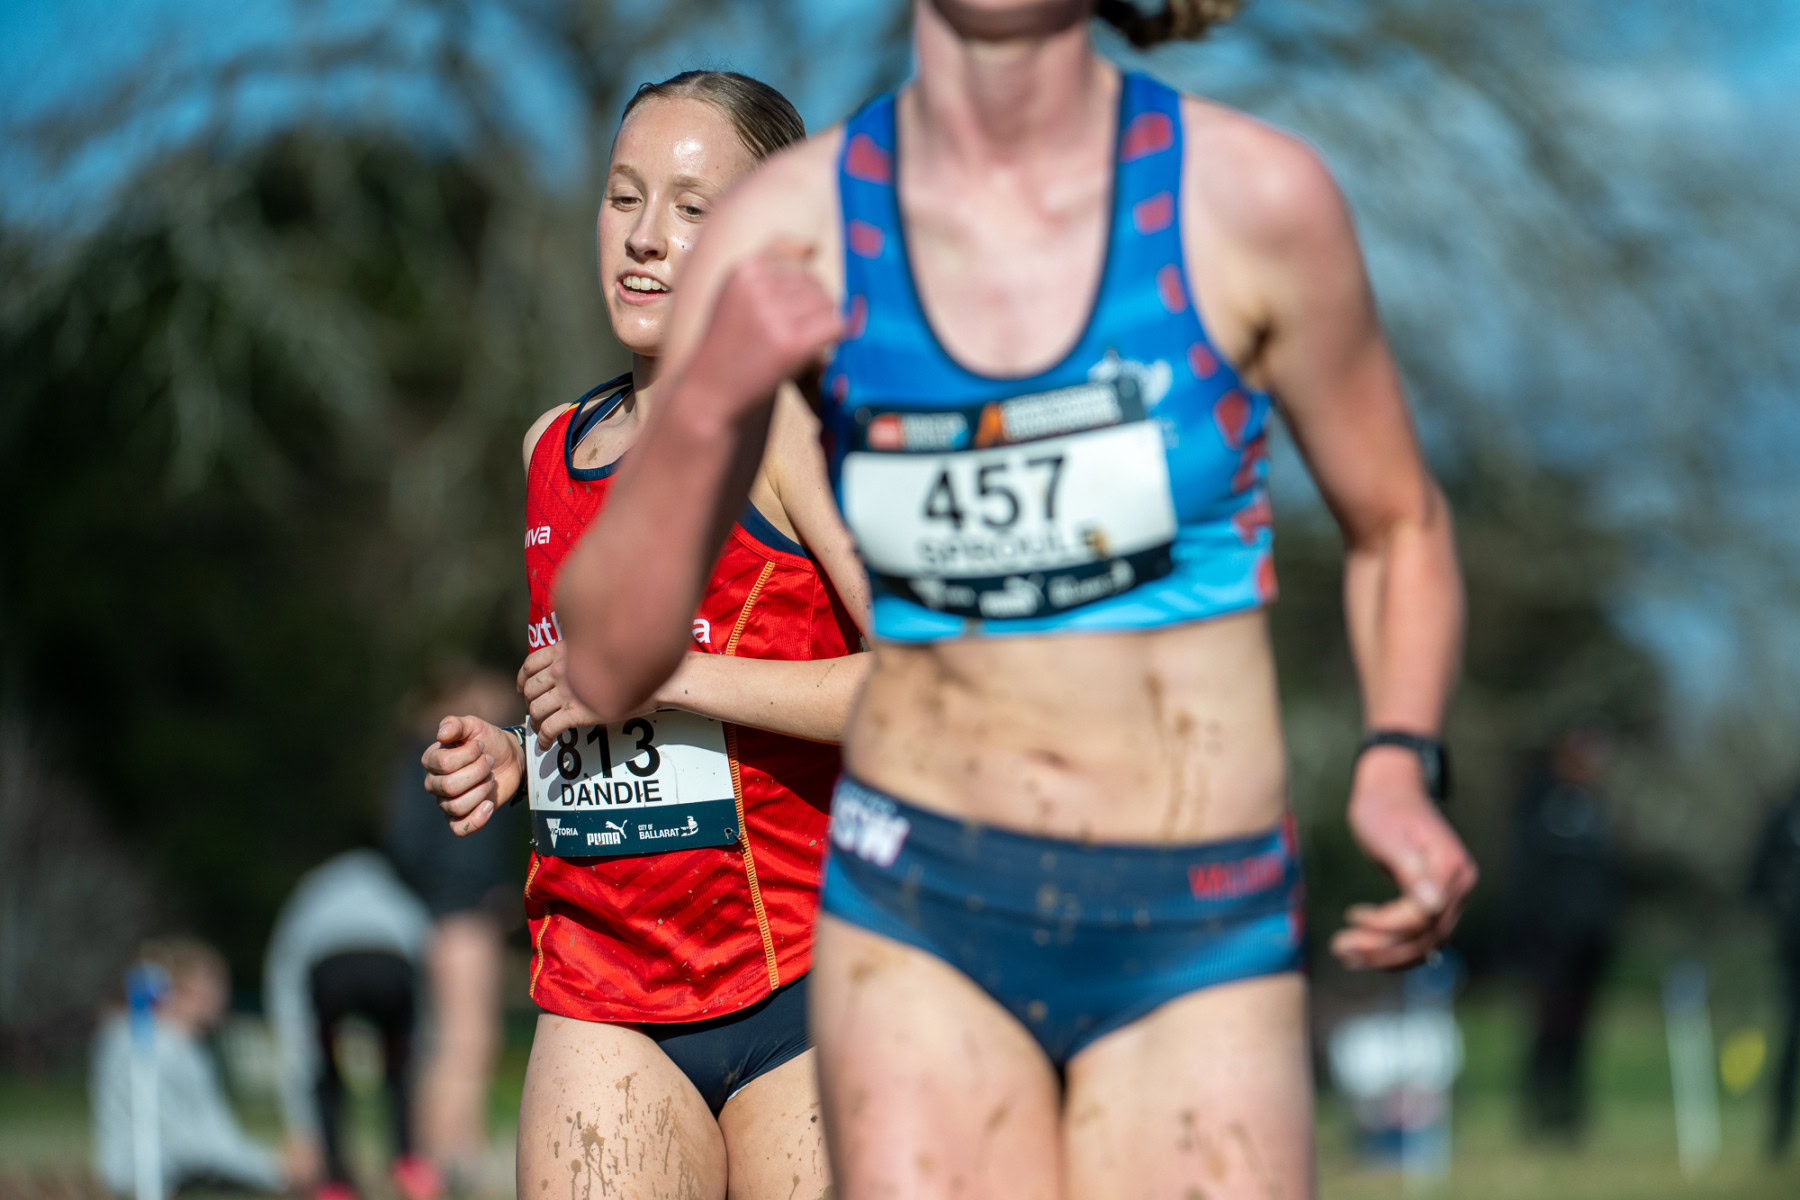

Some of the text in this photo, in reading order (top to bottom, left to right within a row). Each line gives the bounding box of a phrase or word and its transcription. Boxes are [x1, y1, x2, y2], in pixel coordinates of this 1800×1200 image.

[922, 455, 1068, 530] 457
[557, 717, 660, 780] 813
[561, 779, 662, 806] DANDIE
[587, 832, 622, 846] PUMA
[639, 828, 679, 840] BALLARAT
